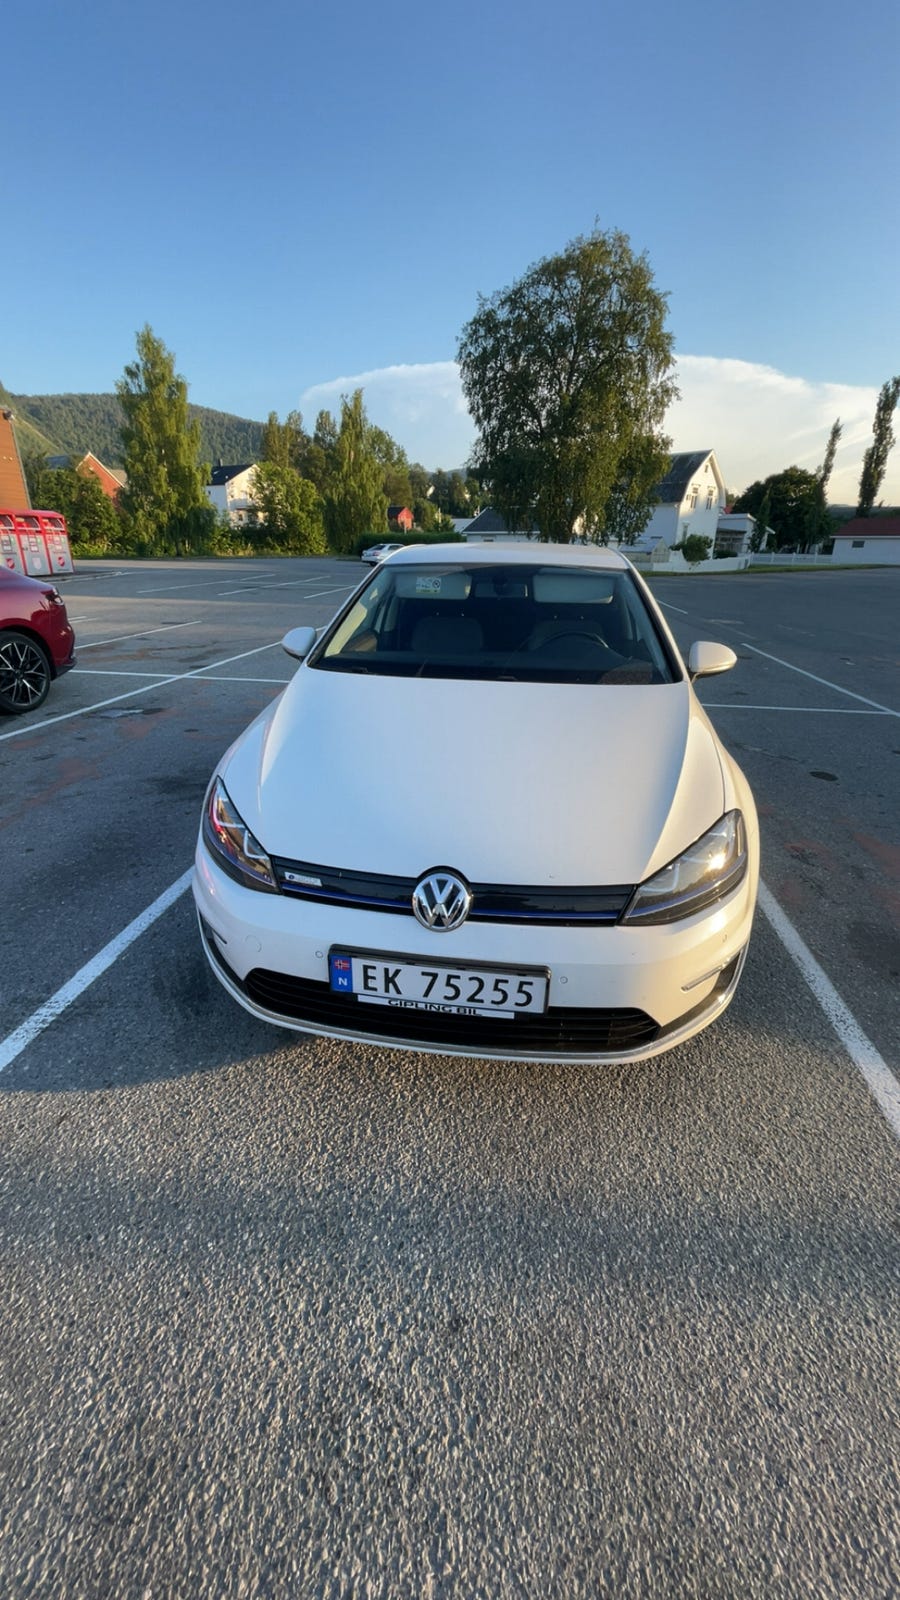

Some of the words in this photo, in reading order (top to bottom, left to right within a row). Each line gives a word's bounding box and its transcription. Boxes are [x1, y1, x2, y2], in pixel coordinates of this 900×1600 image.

[414, 874, 469, 931] VW
[338, 977, 348, 986] N
[362, 964, 403, 995] EK
[421, 971, 534, 1007] 75255
[456, 1007, 482, 1016] BIL
